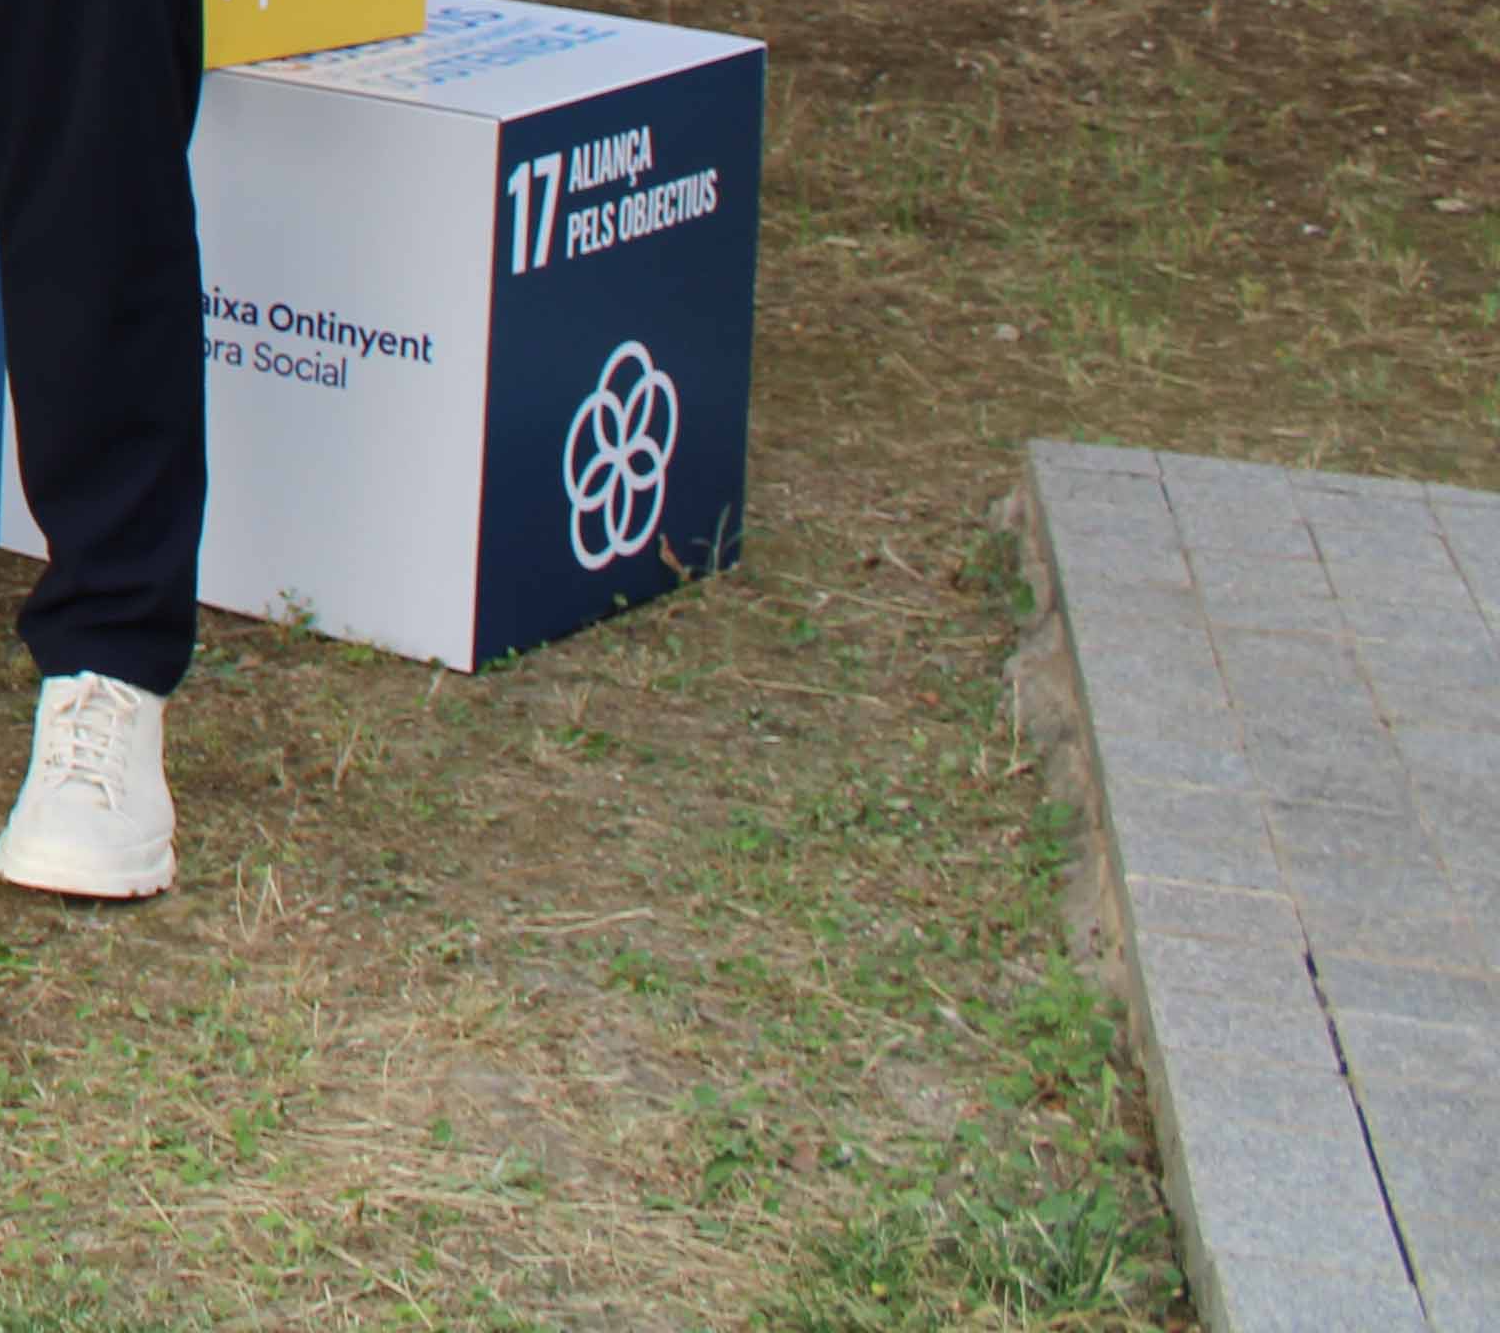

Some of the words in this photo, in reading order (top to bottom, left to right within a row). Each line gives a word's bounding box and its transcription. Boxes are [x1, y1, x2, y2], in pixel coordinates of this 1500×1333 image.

[569, 125, 653, 193] ALIANÇA
[507, 151, 562, 276] 17
[567, 201, 615, 260] PELS
[618, 167, 718, 242] OBJECTIUS
[253, 341, 348, 389] Social
[268, 303, 434, 364] Ontinyent
